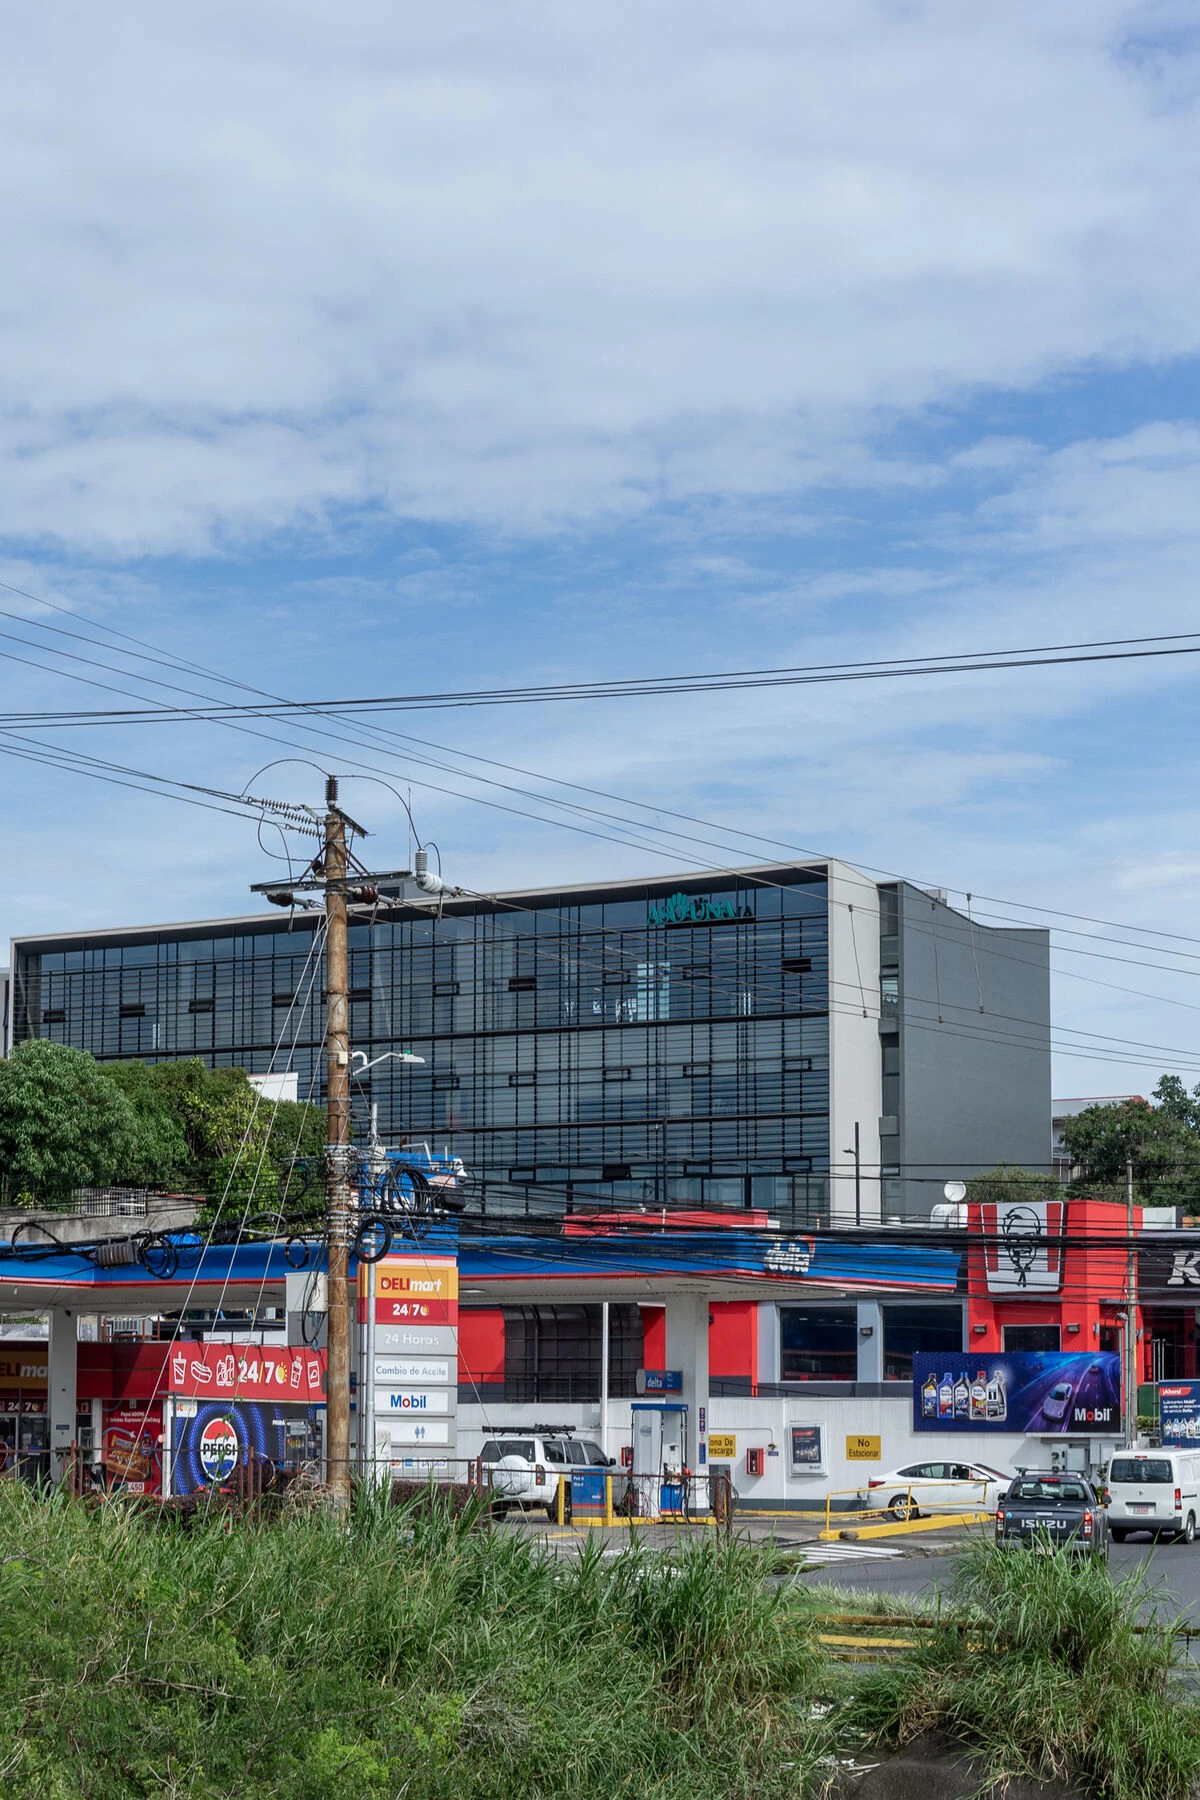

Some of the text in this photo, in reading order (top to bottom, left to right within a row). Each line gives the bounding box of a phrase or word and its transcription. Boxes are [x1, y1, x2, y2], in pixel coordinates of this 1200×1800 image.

[381, 1277, 442, 1292] DELImart
[392, 1303, 420, 1316] 24/7
[384, 1333, 440, 1344] 24 Horas
[238, 1360, 274, 1384] 24/7
[375, 1365, 446, 1376] Cambio de Aceite
[647, 1377, 662, 1388] delta
[7, 1402, 31, 1411] 247
[390, 1394, 427, 1408] Mobil
[1074, 1408, 1110, 1422] Mobil
[857, 1439, 870, 1447] No
[203, 1443, 237, 1456] PEPSI
[709, 1447, 733, 1456] escarga
[848, 1449, 879, 1458] Estacionar
[1021, 1519, 1067, 1529] ISUZU
